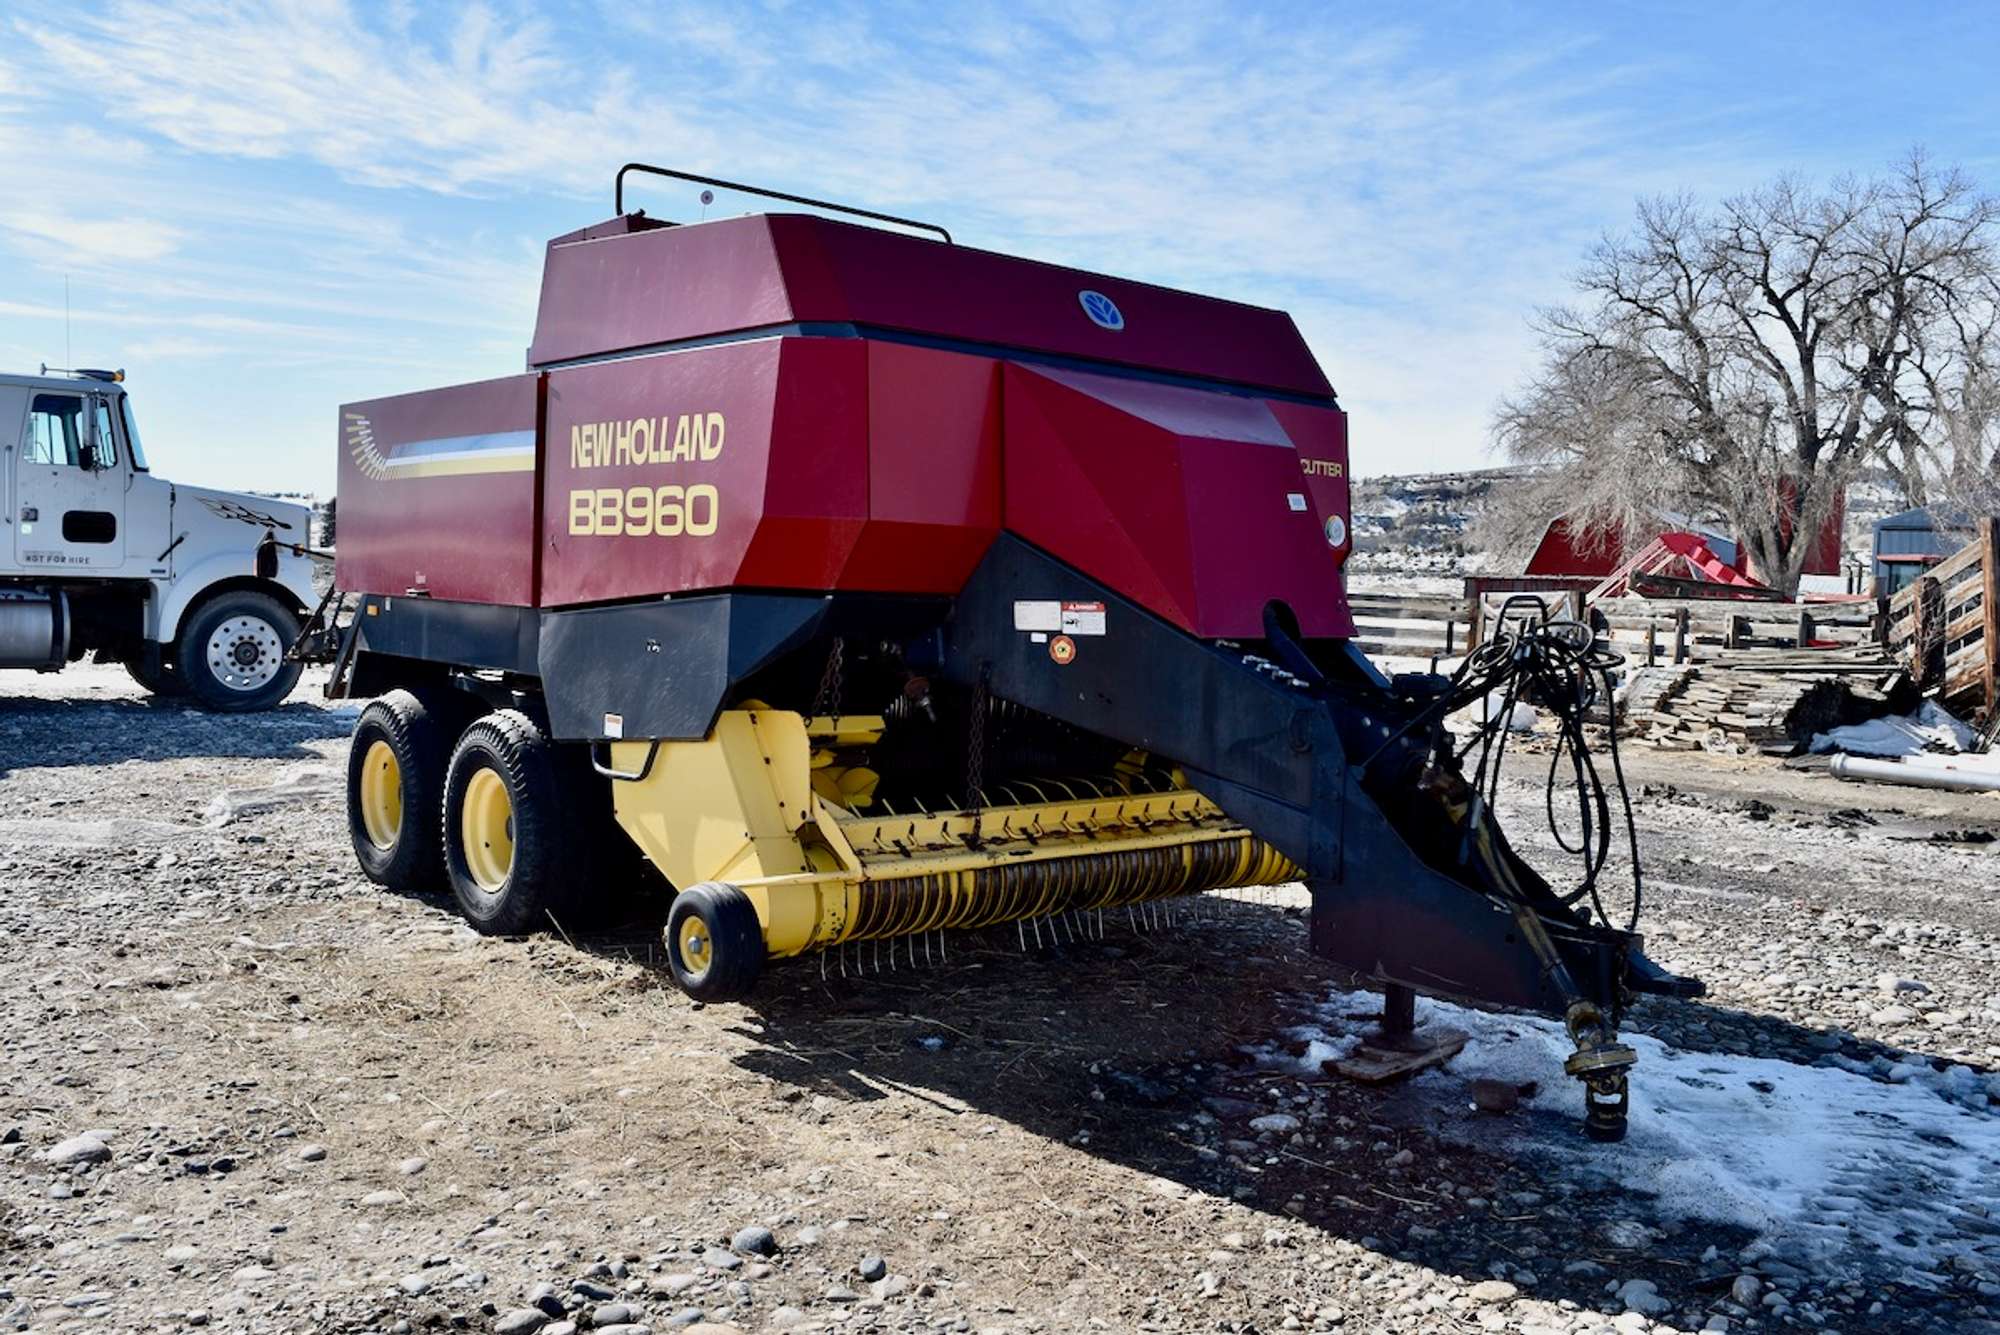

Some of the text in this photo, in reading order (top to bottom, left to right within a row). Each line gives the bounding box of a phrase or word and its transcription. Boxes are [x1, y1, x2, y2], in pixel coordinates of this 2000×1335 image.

[571, 412, 725, 469] NEW HOLLAND
[1300, 458, 1343, 478] CUTTER
[568, 484, 719, 537] BB960
[47, 555, 66, 563] FOR
[69, 556, 90, 564] HIRE
